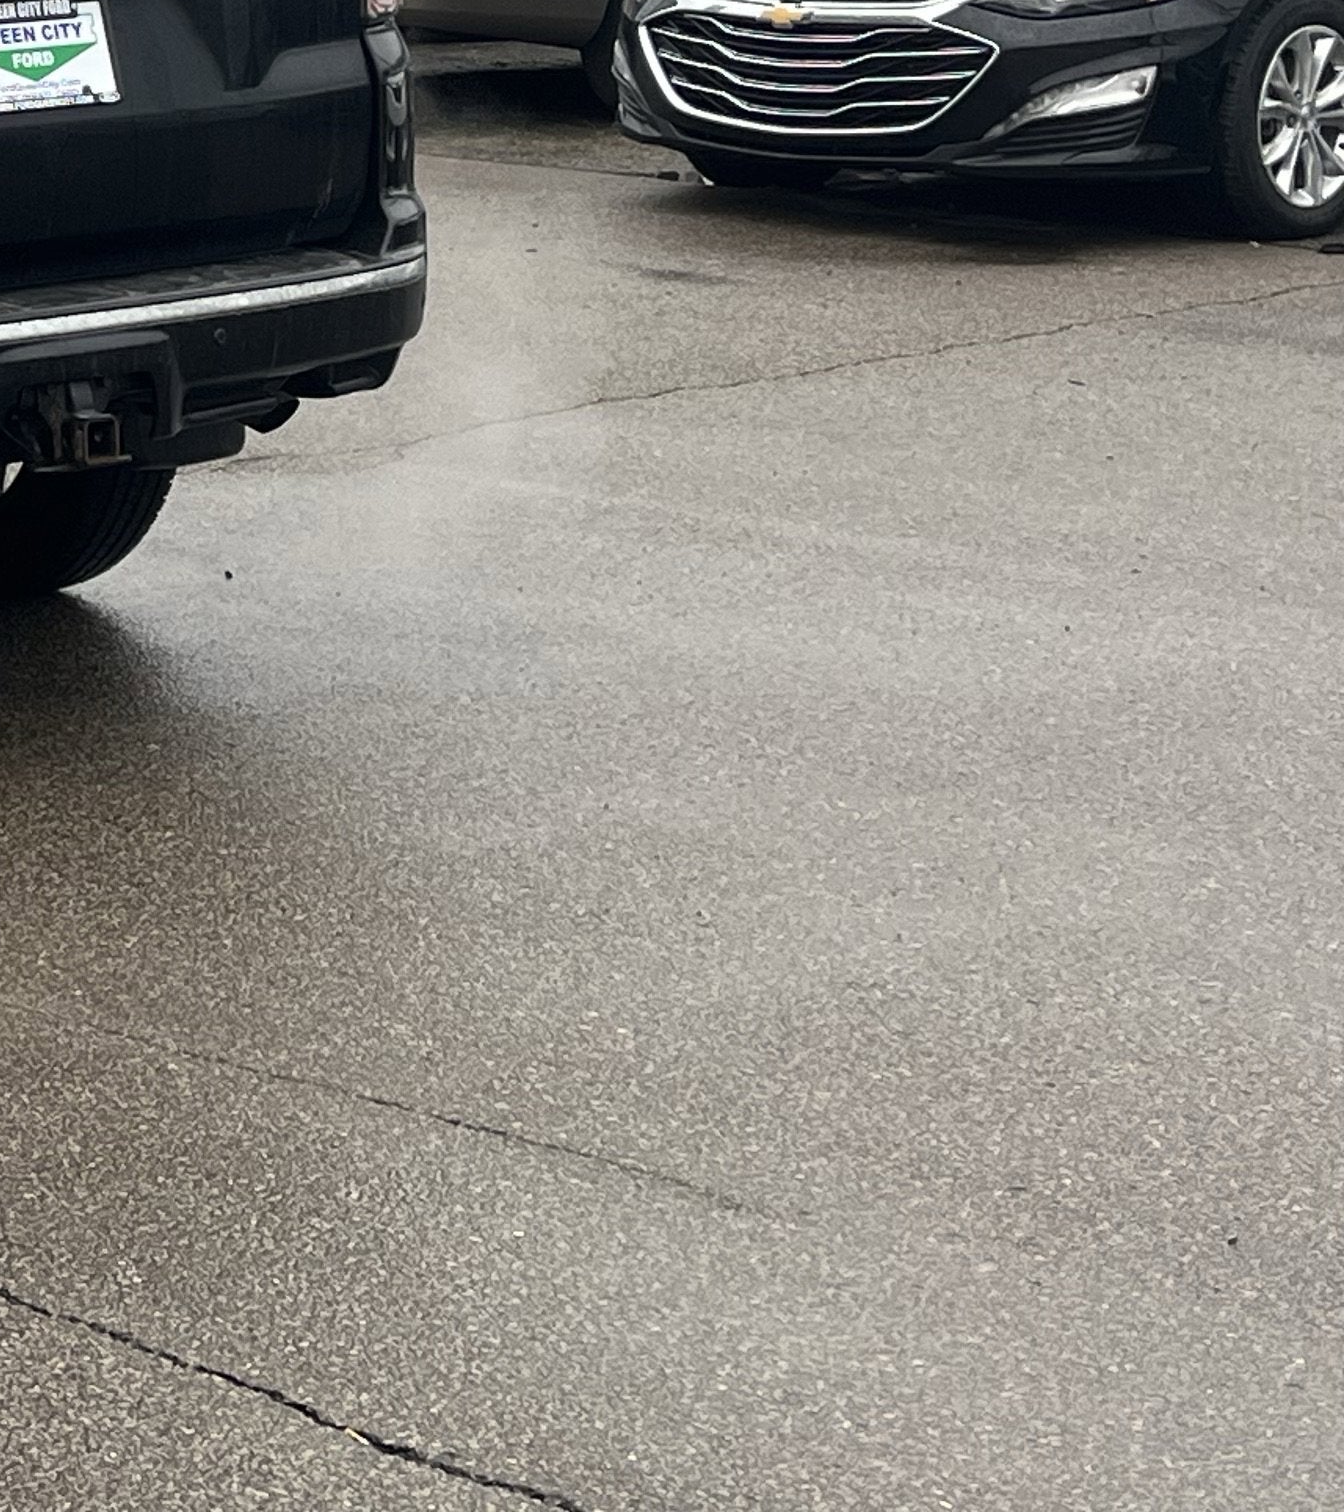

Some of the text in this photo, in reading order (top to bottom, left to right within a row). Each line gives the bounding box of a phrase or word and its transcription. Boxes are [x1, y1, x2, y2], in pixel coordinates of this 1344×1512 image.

[17, 0, 42, 18] CITY
[41, 22, 83, 40] CITY
[11, 50, 55, 69] FORD
